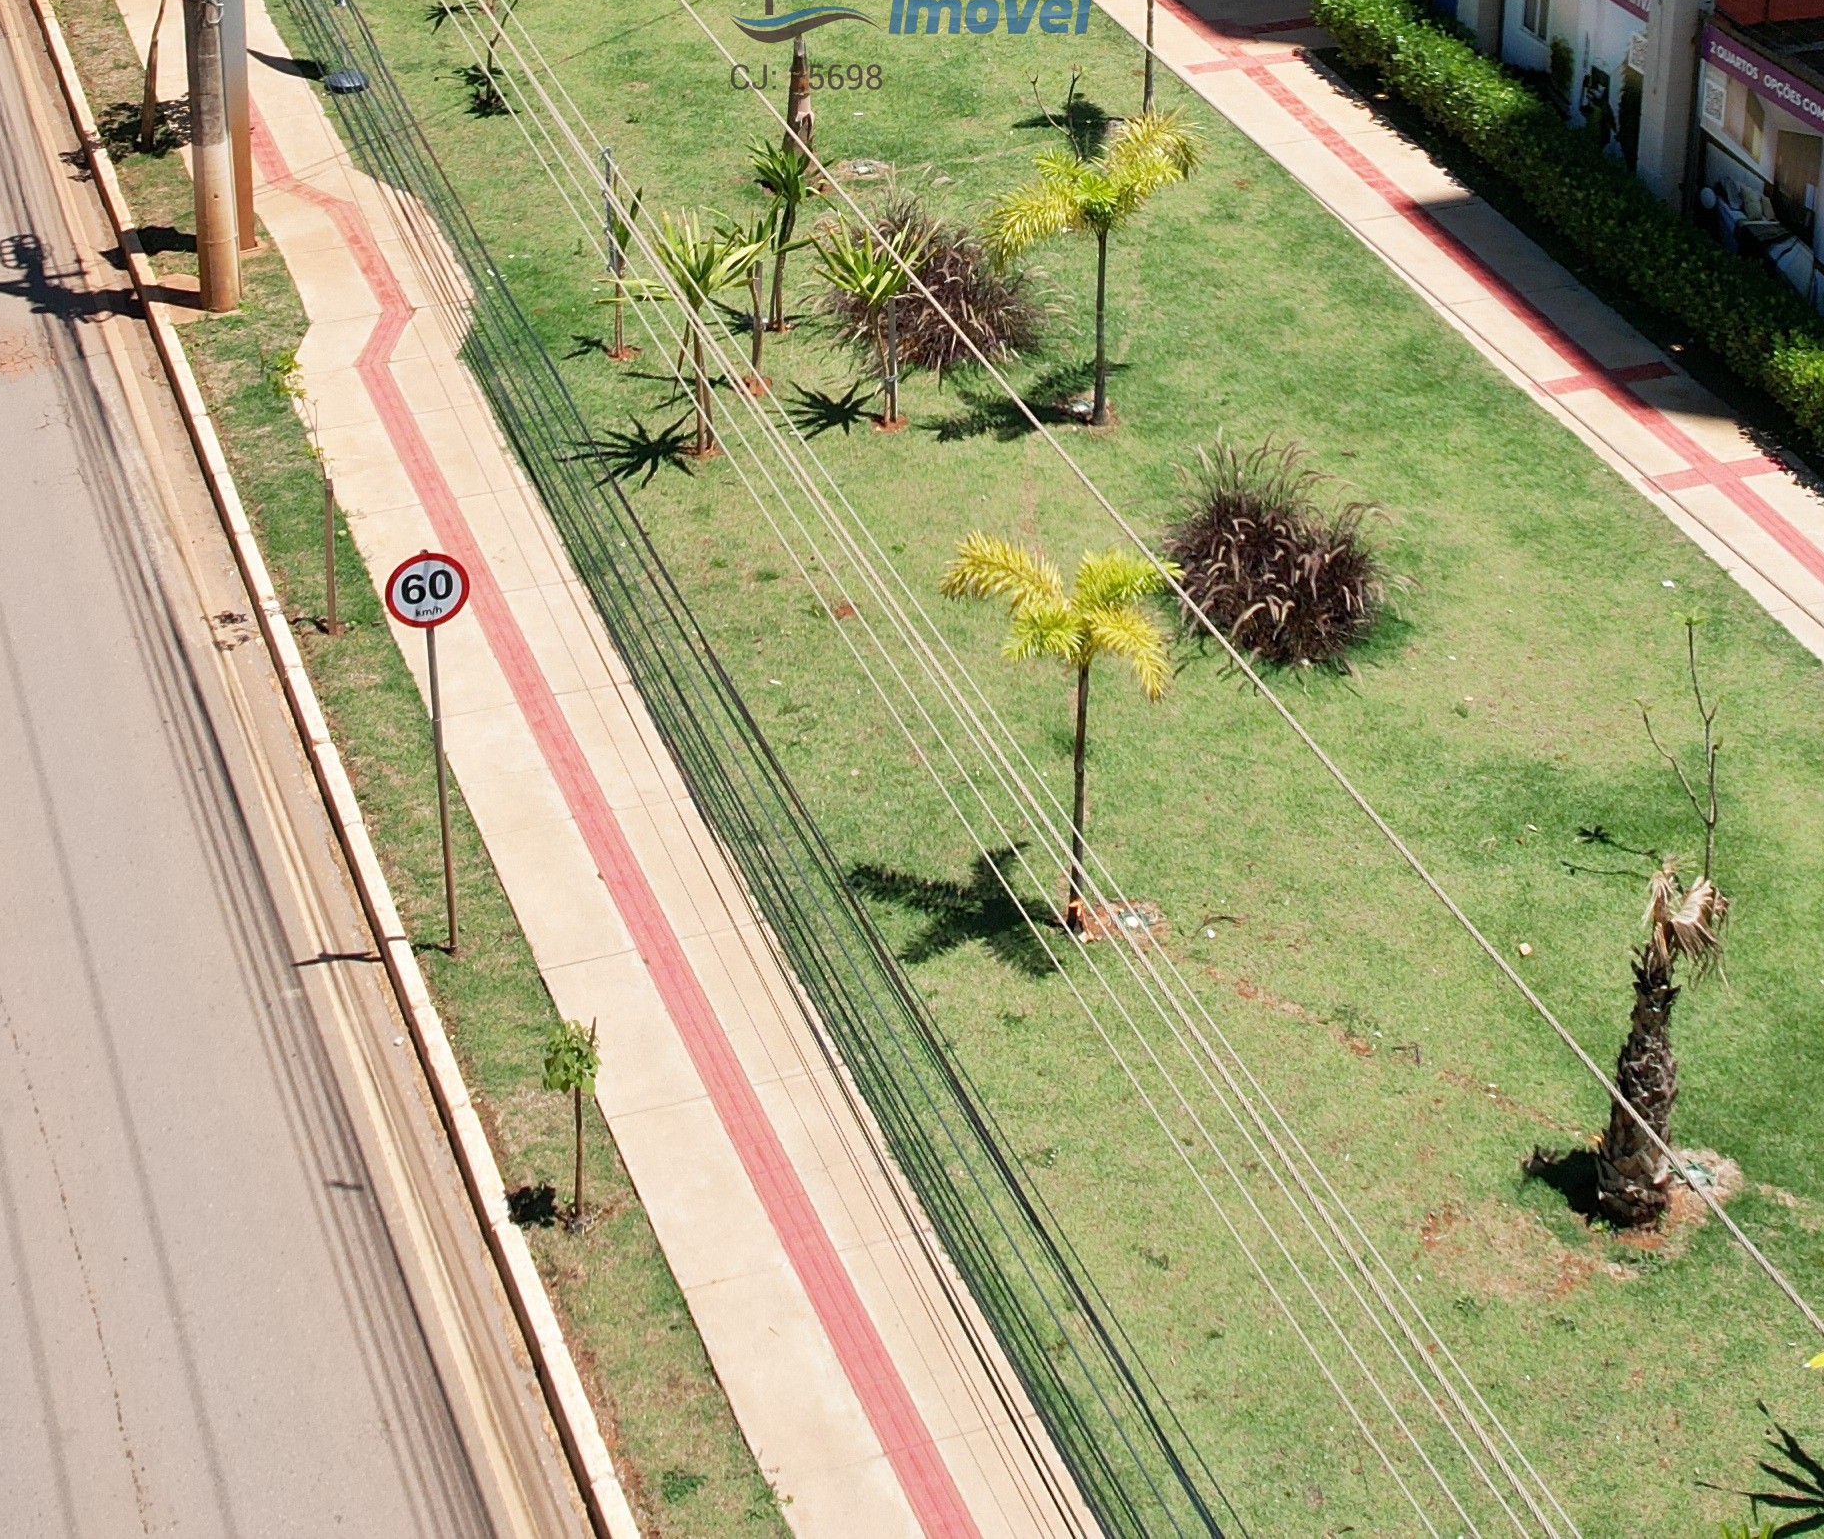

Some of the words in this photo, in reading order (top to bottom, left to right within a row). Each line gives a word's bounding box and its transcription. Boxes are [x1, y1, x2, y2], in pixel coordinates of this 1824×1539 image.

[1709, 41, 1716, 54] 2
[1717, 45, 1759, 80] QUARTOS
[1763, 74, 1802, 107] OPÇÕES
[401, 569, 454, 605] 60
[415, 606, 443, 617] km/h
